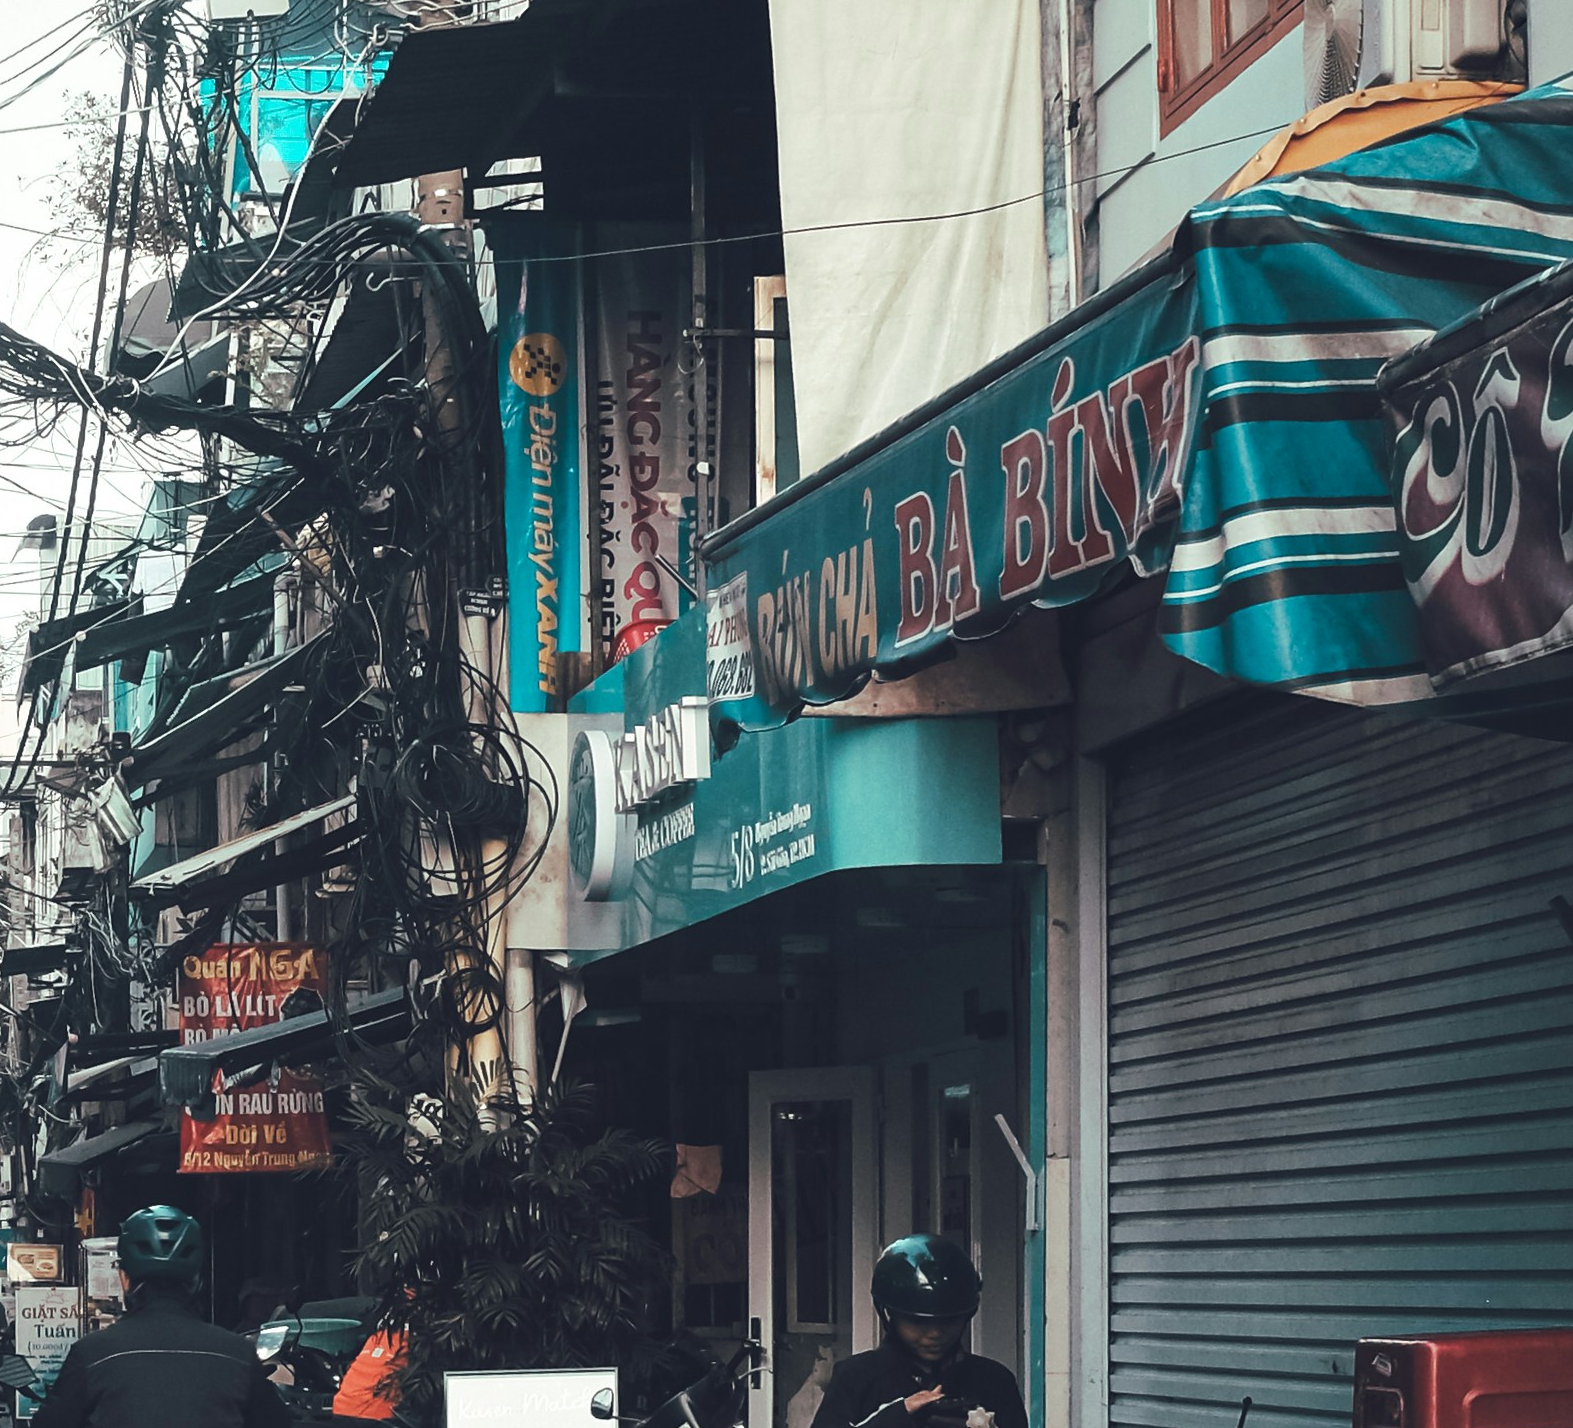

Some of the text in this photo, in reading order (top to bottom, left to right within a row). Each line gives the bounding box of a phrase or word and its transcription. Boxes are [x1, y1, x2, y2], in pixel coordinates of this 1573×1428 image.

[524, 403, 559, 485] Điện
[620, 310, 671, 621] HÀNG ĐẶC QU
[527, 492, 559, 575] máy
[819, 486, 878, 679] CHẢ
[895, 426, 981, 648] BÀ
[731, 825, 754, 889] 5/8
[184, 991, 210, 1017] BÒ
[239, 1093, 274, 1115] RAU
[22, 1304, 57, 1323] GIẶT
